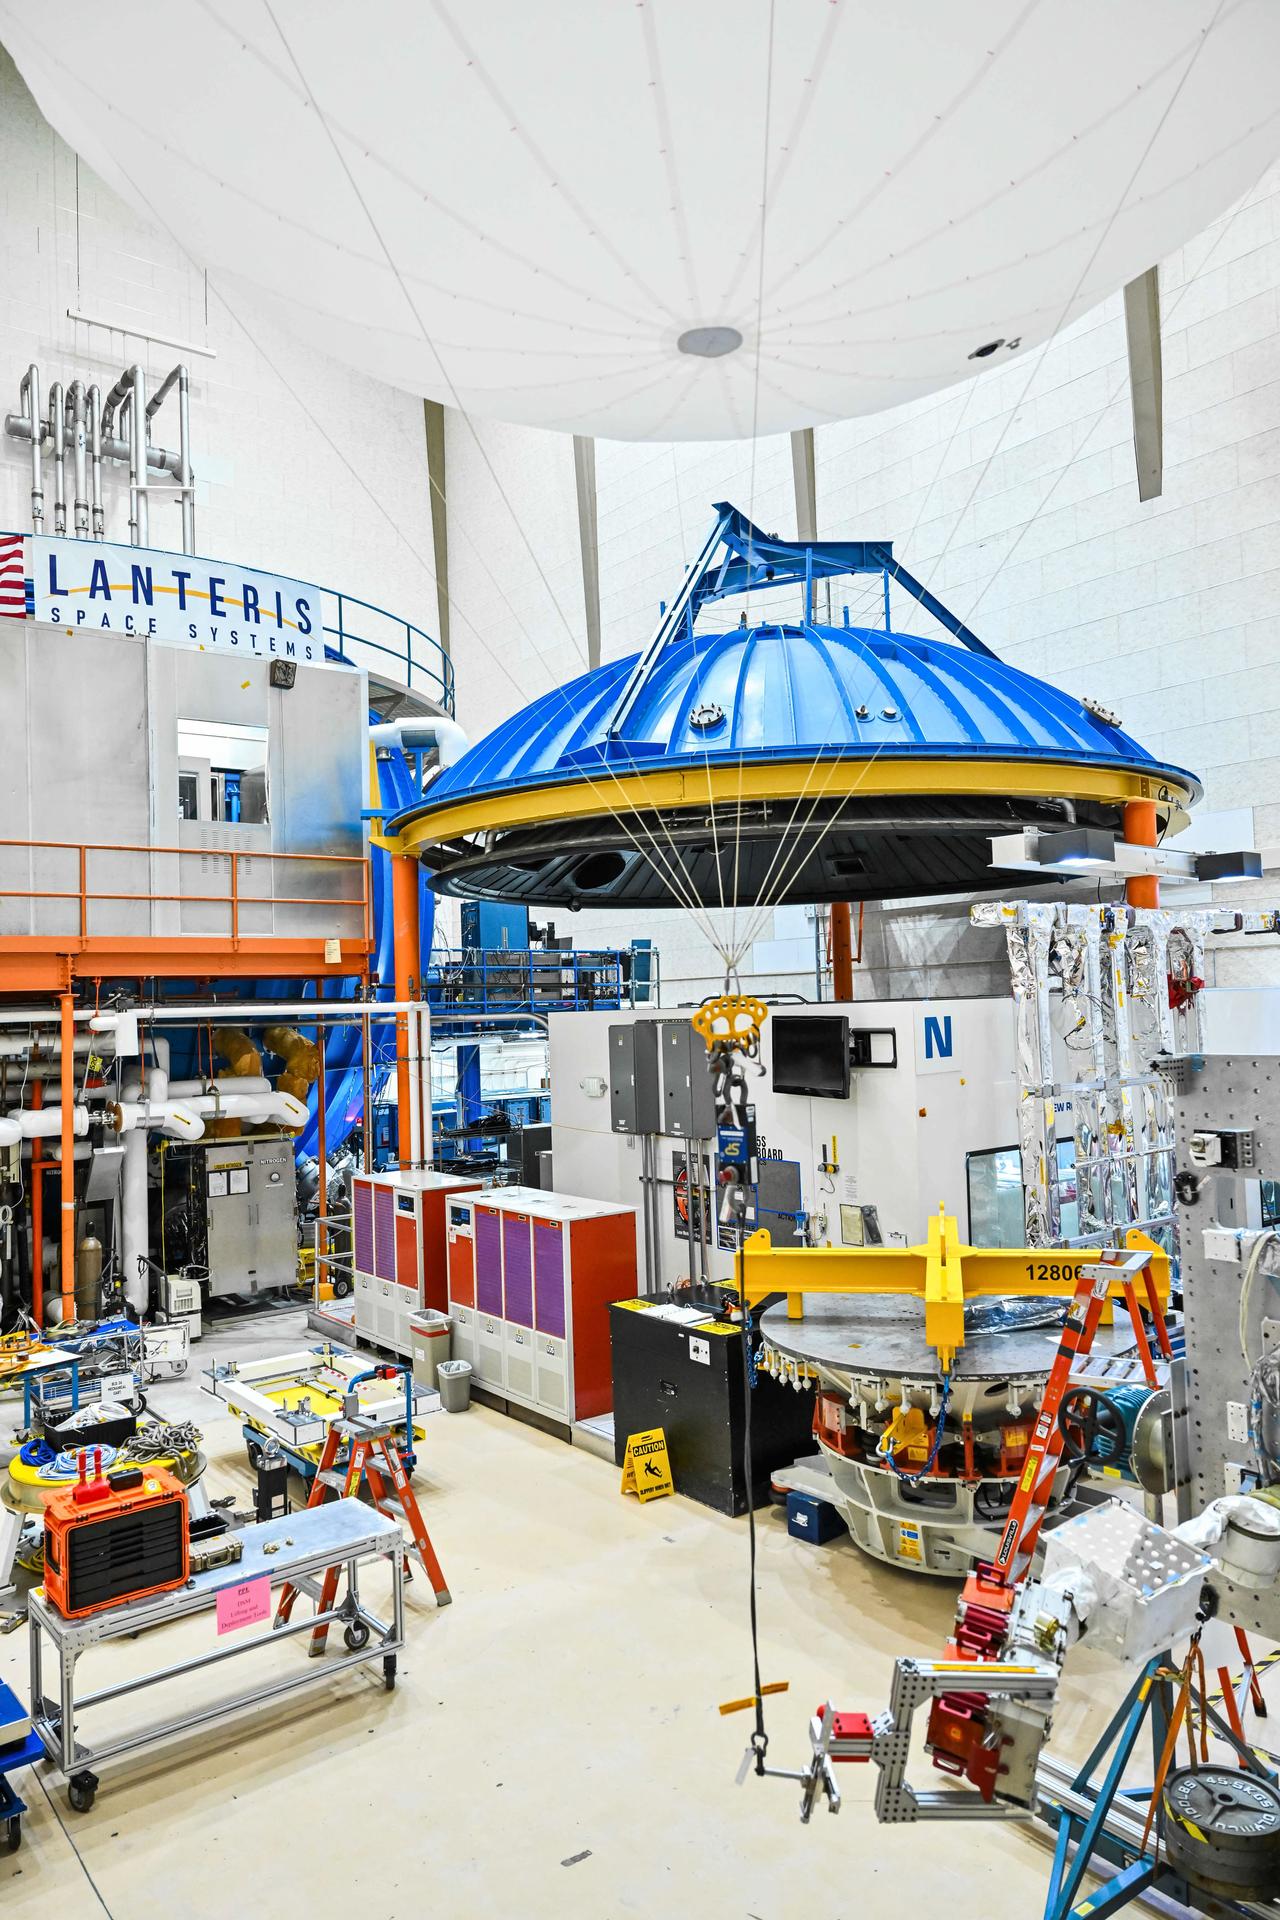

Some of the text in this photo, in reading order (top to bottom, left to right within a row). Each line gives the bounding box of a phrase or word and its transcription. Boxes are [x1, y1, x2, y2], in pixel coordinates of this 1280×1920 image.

[48, 554, 313, 635] LANTERIS
[51, 607, 312, 660] SPACE SYSTEMS
[924, 1015, 953, 1059] N
[260, 1157, 287, 1165] NITROGEN
[757, 1147, 783, 1161] BOARD
[633, 1441, 665, 1456] CAUTION
[1002, 1521, 1017, 1558] LOUISVILLE
